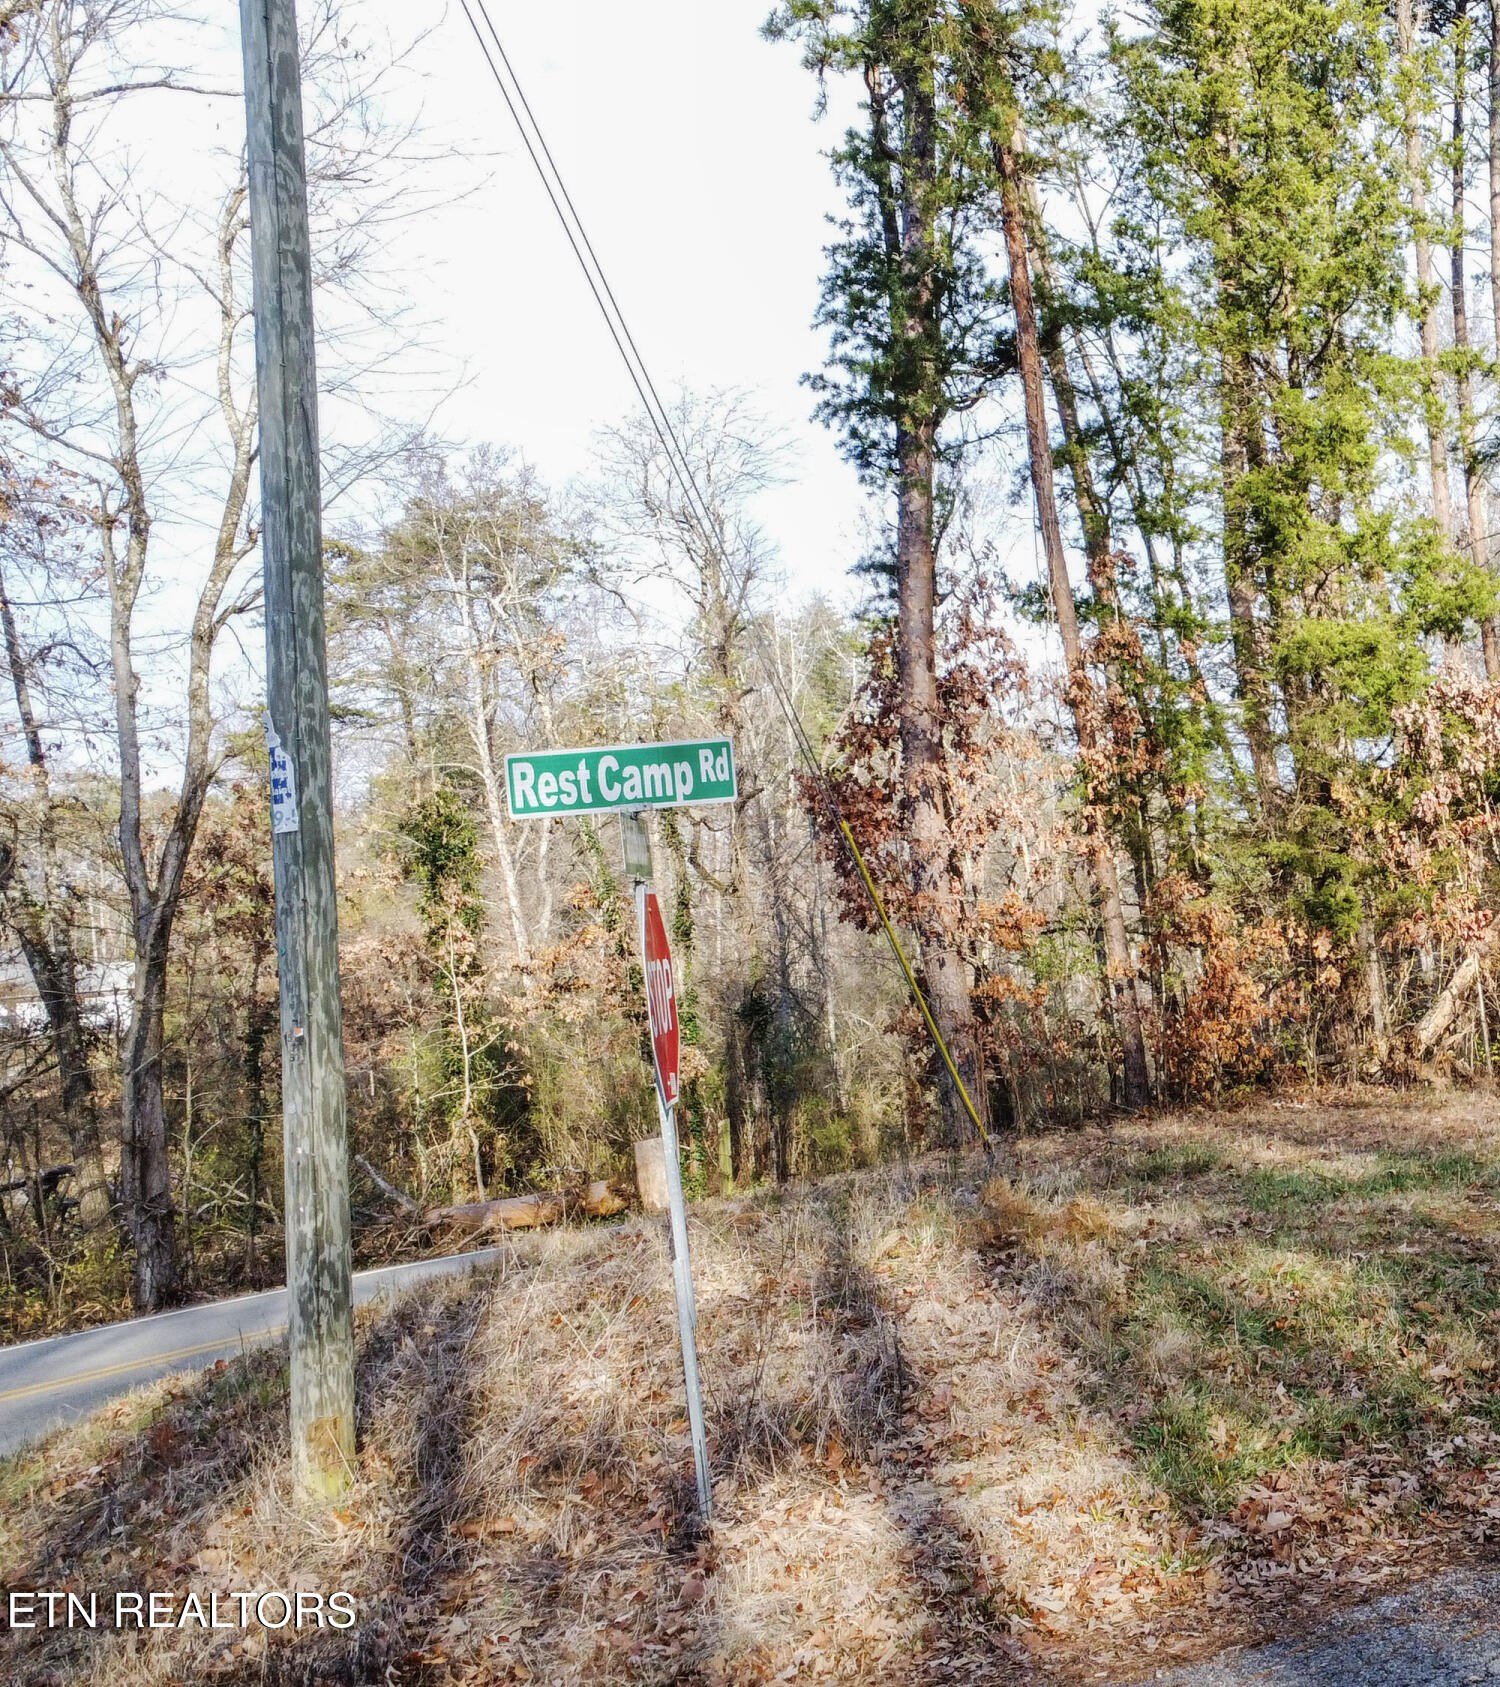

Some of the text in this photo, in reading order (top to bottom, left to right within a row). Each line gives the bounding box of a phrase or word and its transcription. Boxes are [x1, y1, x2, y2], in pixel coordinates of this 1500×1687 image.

[511, 747, 730, 809] Rest Camp Rd
[647, 958, 673, 1038] STOP
